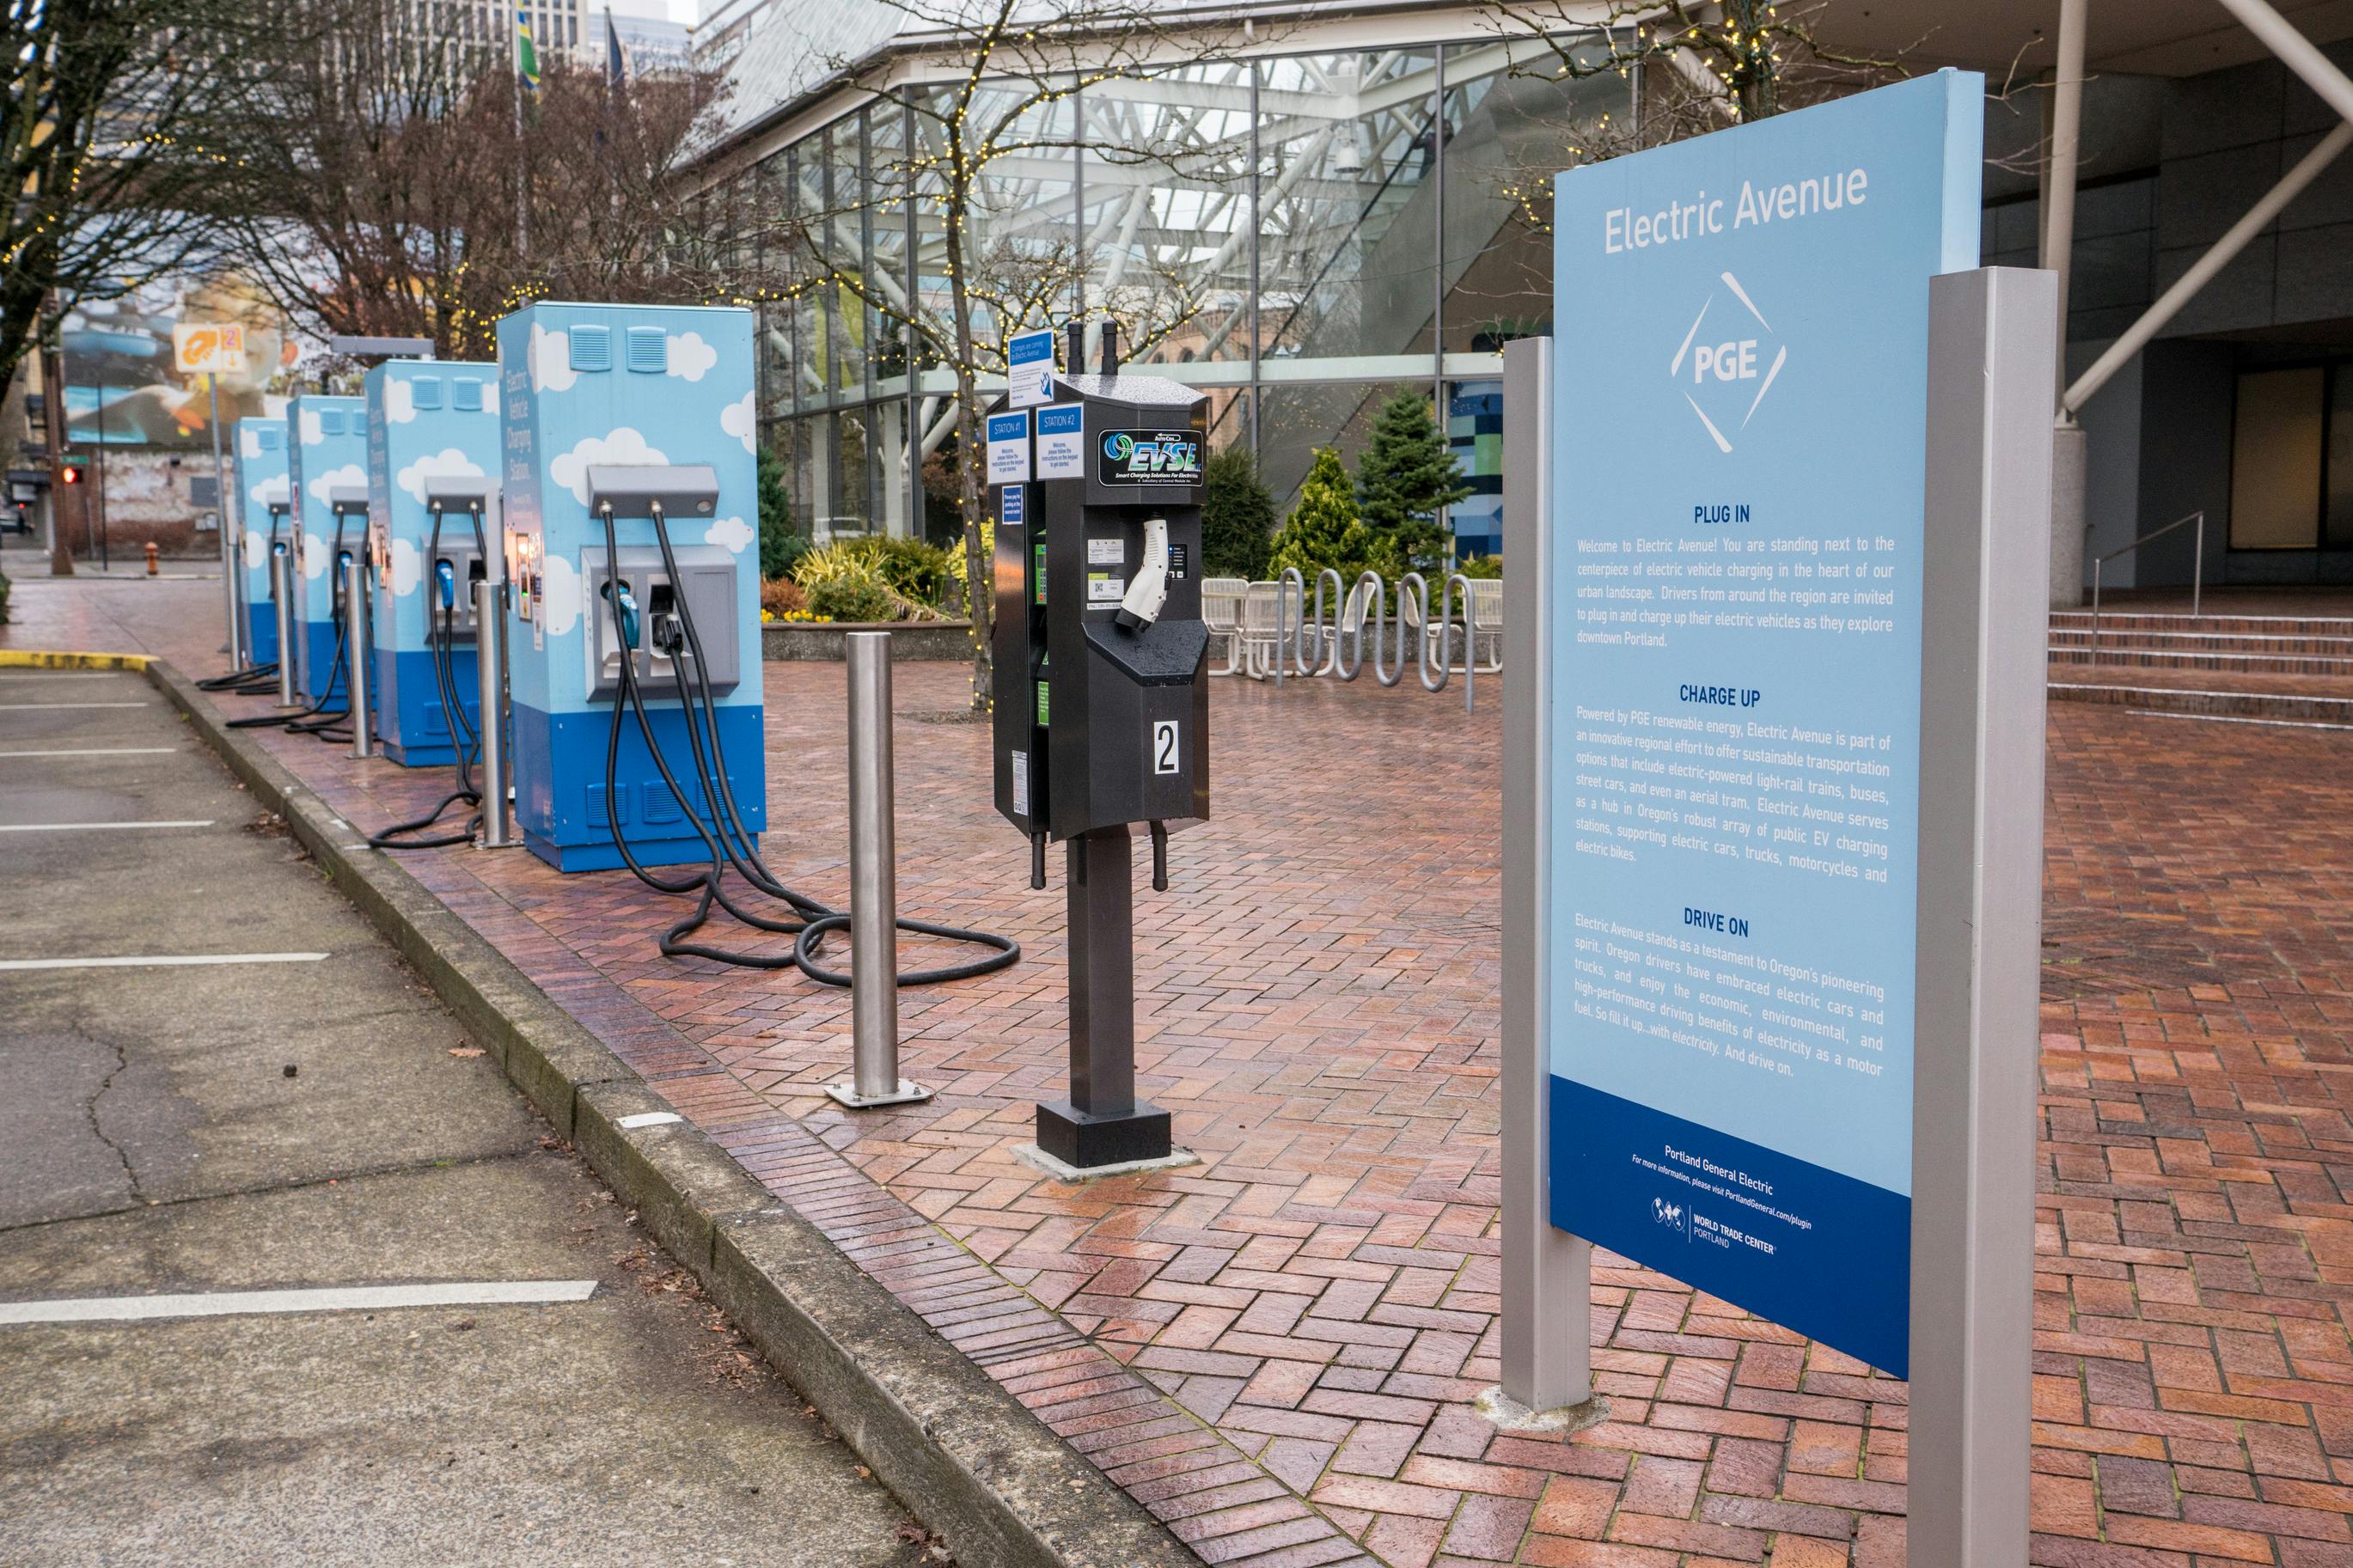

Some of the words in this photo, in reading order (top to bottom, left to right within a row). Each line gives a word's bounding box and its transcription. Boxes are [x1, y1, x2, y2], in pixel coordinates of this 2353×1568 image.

[1605, 191, 1723, 253] Electric
[1733, 168, 1867, 229] Avenue
[225, 329, 236, 345] 2
[1694, 339, 1757, 384] PGE
[994, 423, 1014, 434] STATION
[1015, 422, 1020, 430] #1
[1044, 416, 1066, 428] STATION
[1067, 414, 1074, 424] #2
[1128, 442, 1197, 471] EVSE
[1694, 504, 1731, 524] PLUG
[1735, 504, 1750, 523] IN
[1577, 539, 1618, 553] Welcome
[1622, 540, 1632, 552] to
[1636, 538, 1673, 552] Electric
[1678, 537, 1717, 552] Avenue!
[1722, 537, 1741, 552] You
[1746, 540, 1765, 552] are
[1770, 536, 1818, 556] standing
[1824, 536, 1850, 552] next
[1856, 536, 1869, 552] to
[1874, 535, 1895, 551] the
[1577, 562, 1629, 578] centerpiece
[1633, 562, 1642, 576] of
[1646, 562, 1683, 577] electric
[1687, 562, 1722, 577] vehicle
[1727, 562, 1774, 581] charging
[1778, 562, 1789, 577] in
[1794, 562, 1812, 577] the
[1818, 562, 1850, 578] heart
[1855, 562, 1868, 578] of
[1873, 565, 1895, 578] our
[1577, 584, 1604, 598] urban
[1605, 584, 1654, 602] landscape.
[1661, 585, 1698, 601] Drivers
[1700, 586, 1725, 601] from
[1728, 588, 1765, 602] around
[1769, 588, 1787, 603] the
[1790, 588, 1826, 607] region
[1830, 592, 1850, 605] are
[1854, 589, 1894, 606] invited
[1577, 629, 1623, 644] downtown
[1624, 631, 1667, 647] Portland.
[1680, 684, 1736, 706] CHARGE
[1740, 689, 1761, 708] UP
[1576, 705, 1615, 722] Powered
[1617, 709, 1629, 727] by
[1630, 710, 1651, 726] PGE
[1653, 716, 1703, 731] renewable
[1706, 721, 1744, 739] energy,
[1747, 722, 1788, 740] Electric
[1791, 726, 1832, 745] Avenue
[1836, 729, 1847, 746] is
[1849, 735, 1875, 750] part
[1879, 735, 1892, 751] of
[1158, 724, 1175, 771] 2
[1576, 751, 1608, 766] options
[1610, 754, 1628, 769] that
[1631, 759, 1665, 774] include
[1668, 762, 1753, 785] electric-powered
[1757, 772, 1804, 792] light-rail
[1808, 780, 1844, 800] trains,
[1849, 784, 1889, 806] buses,
[1575, 818, 1612, 836] stations,
[1617, 826, 1667, 848] supporting
[1672, 833, 1708, 851] electric
[1714, 843, 1739, 859] cars,
[1745, 845, 1782, 867] trucks,
[1788, 855, 1859, 878] motorcycles
[1864, 867, 1887, 883] and
[1575, 839, 1609, 857] electric
[1610, 845, 1637, 862] bikes.
[1684, 906, 1725, 932] DRIVE
[1728, 917, 1749, 938] ON
[1575, 912, 1609, 933] Electric
[1610, 921, 1644, 941] Avenue
[1646, 930, 1678, 949] stands
[1679, 940, 1692, 953] as
[1693, 943, 1700, 955] a
[1702, 943, 1755, 967] testament
[1756, 955, 1768, 971] to
[1821, 971, 1885, 1004] pioneering
[1574, 937, 1601, 953] spirit.
[1606, 943, 1641, 963] Oregon
[1646, 953, 1682, 973] drivers
[1686, 961, 1710, 980] have
[1715, 973, 1770, 996] embraced
[1776, 986, 1820, 1010] electric
[1827, 1001, 1854, 1017] cars
[1861, 1010, 1884, 1026] and
[1574, 978, 1656, 1013] high-performance
[1659, 1003, 1694, 1027] driving
[1698, 1012, 1739, 1036] benefits
[1743, 1026, 1753, 1040] of
[1757, 1030, 1812, 1059] electricity
[1815, 1048, 1830, 1063] as
[1834, 1053, 1842, 1066] a
[1847, 1057, 1884, 1077] motor
[1665, 1144, 1701, 1168] Portland
[1702, 1158, 1737, 1182] General
[1739, 1171, 1774, 1196] Electric
[1632, 1154, 1642, 1164] For
[1641, 1159, 1658, 1170] more
[1657, 1165, 1691, 1185] information,
[1691, 1178, 1712, 1191] please
[1712, 1186, 1725, 1196] visit
[1725, 1188, 1812, 1229] PortlandGeneral.com/plugin
[1693, 1213, 1719, 1232] WORLD
[1720, 1223, 1744, 1242] TRADE
[1745, 1235, 1775, 1255] CENTER
[1694, 1226, 1730, 1248] PORTLAND
